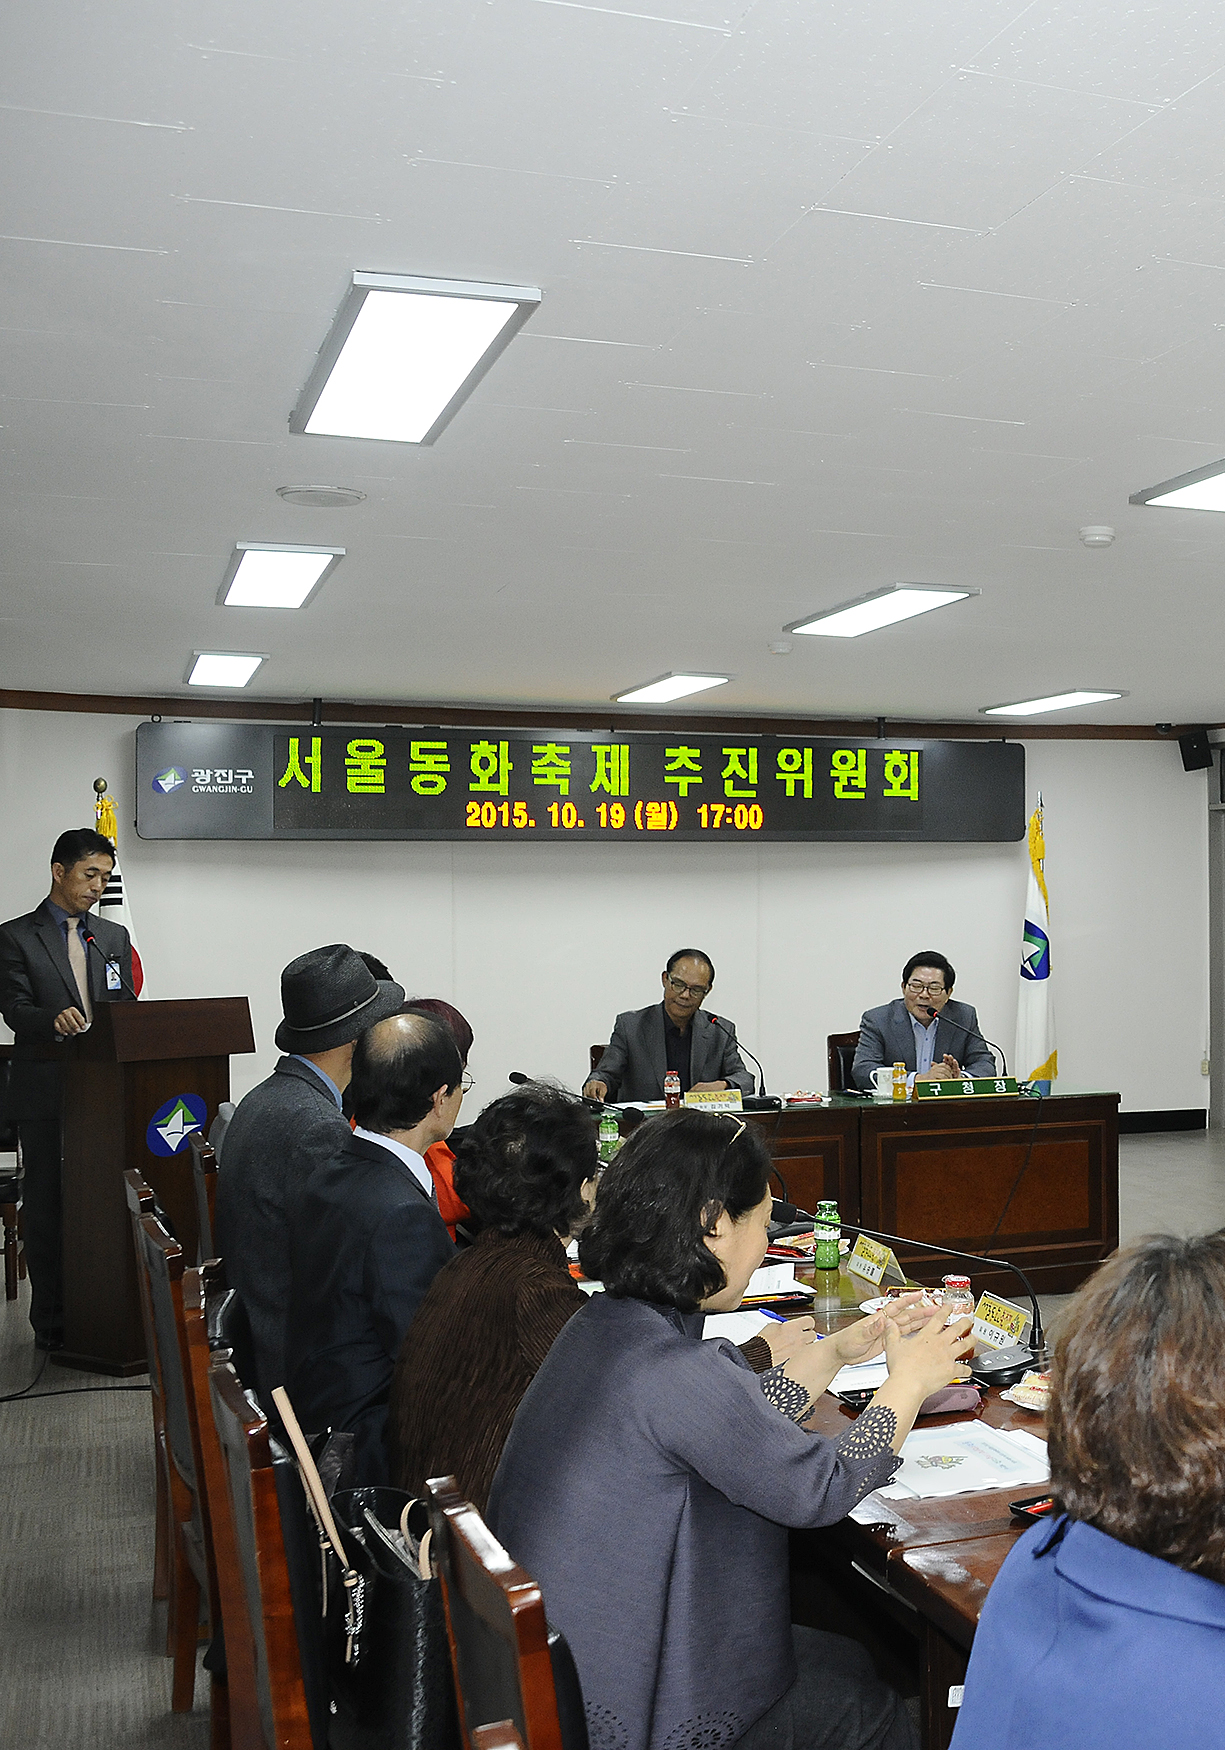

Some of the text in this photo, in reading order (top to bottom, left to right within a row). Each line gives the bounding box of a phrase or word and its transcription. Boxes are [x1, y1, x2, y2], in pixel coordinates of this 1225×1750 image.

[191, 768, 254, 784] 광진구
[277, 737, 919, 801] 서울동화축제 추진위원회
[191, 785, 253, 793] GWANGJIN-GU
[465, 801, 764, 830] 2015. 10. 19 (월) 17:00
[928, 1080, 1007, 1096] 구청장
